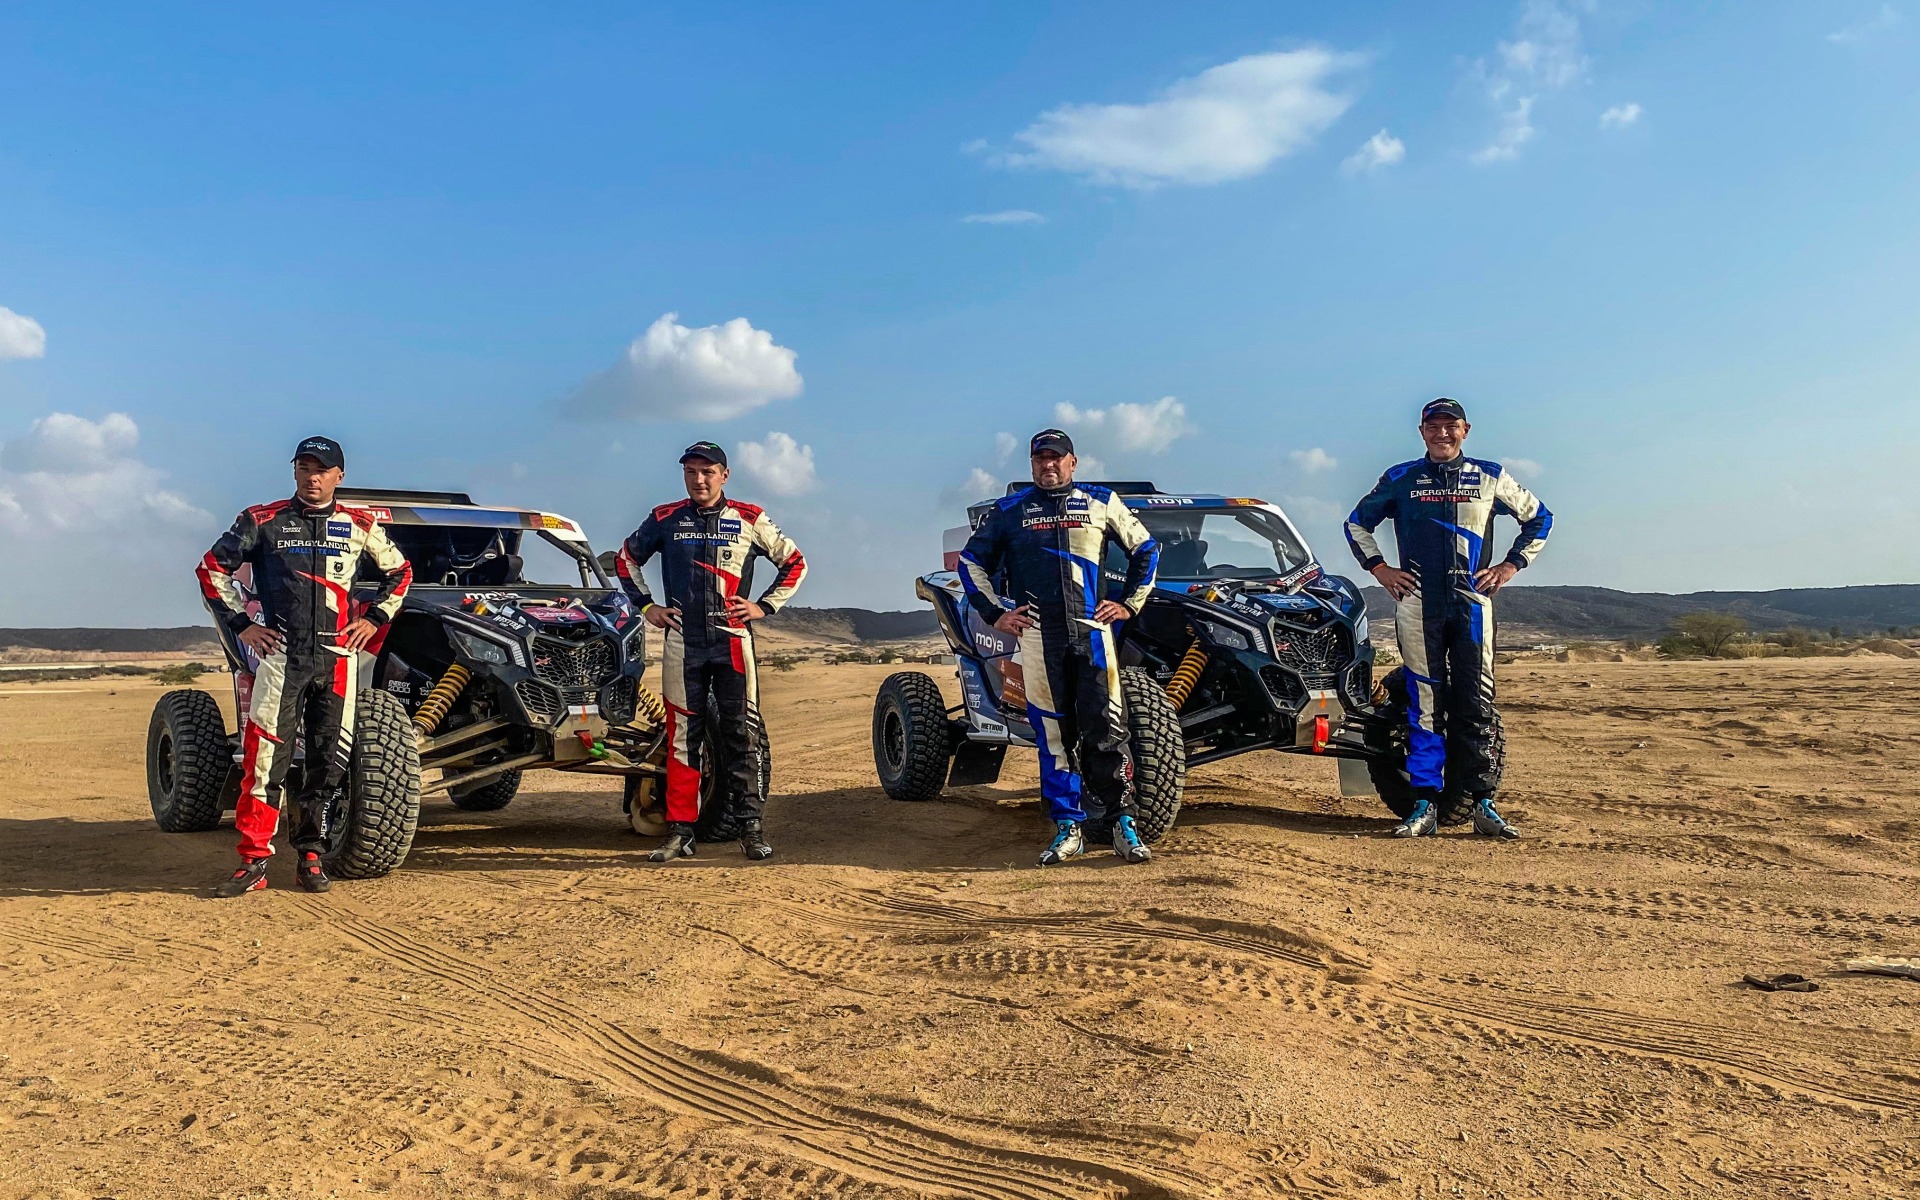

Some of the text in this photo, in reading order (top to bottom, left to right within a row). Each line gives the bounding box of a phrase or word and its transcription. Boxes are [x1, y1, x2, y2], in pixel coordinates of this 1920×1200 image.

[1411, 489, 1480, 499] ENERGYLANDIA
[1147, 498, 1194, 506] moya
[1022, 515, 1092, 527] ENERGYLANDIA
[673, 532, 738, 543] ENERGYLANDIA
[277, 540, 350, 552] ENERGYLANDIA
[976, 631, 1004, 655] moya
[981, 722, 1003, 731] METHOD
